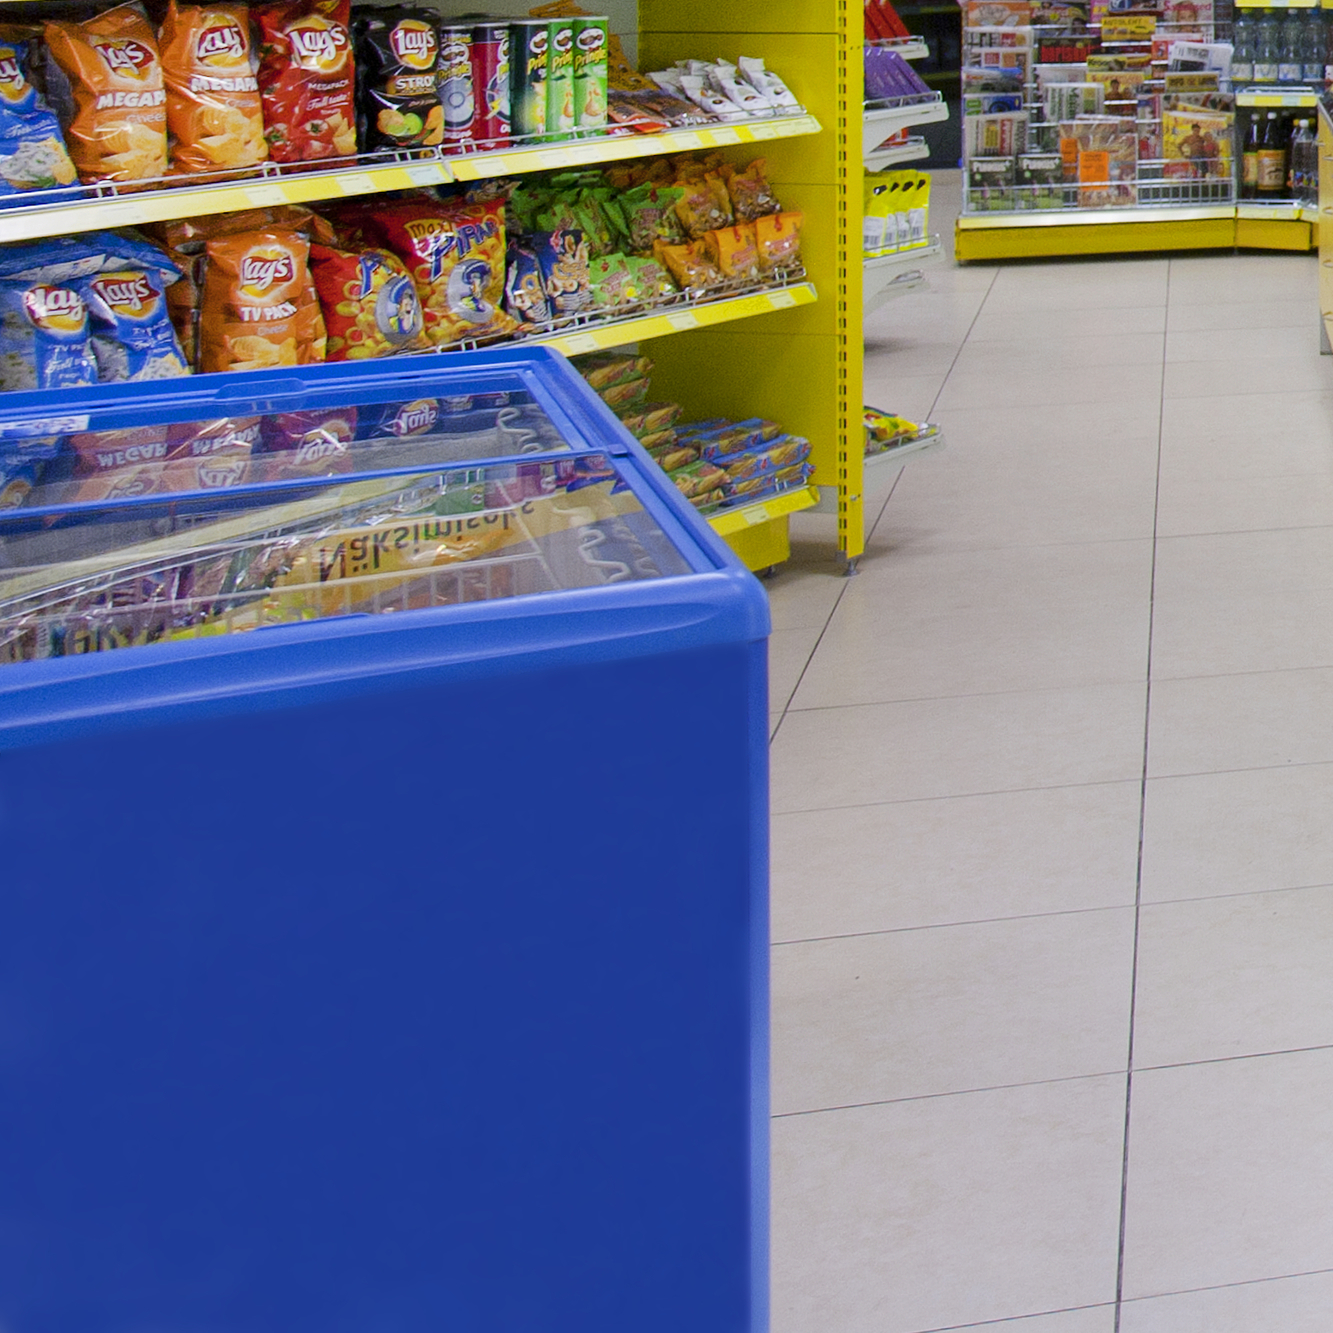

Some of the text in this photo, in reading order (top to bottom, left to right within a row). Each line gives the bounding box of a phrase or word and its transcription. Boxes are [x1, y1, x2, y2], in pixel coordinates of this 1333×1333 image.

[394, 29, 436, 59] Lay's
[242, 255, 292, 290] Lay's
[96, 279, 150, 310] Lay's
[240, 302, 298, 322] TV PACK
